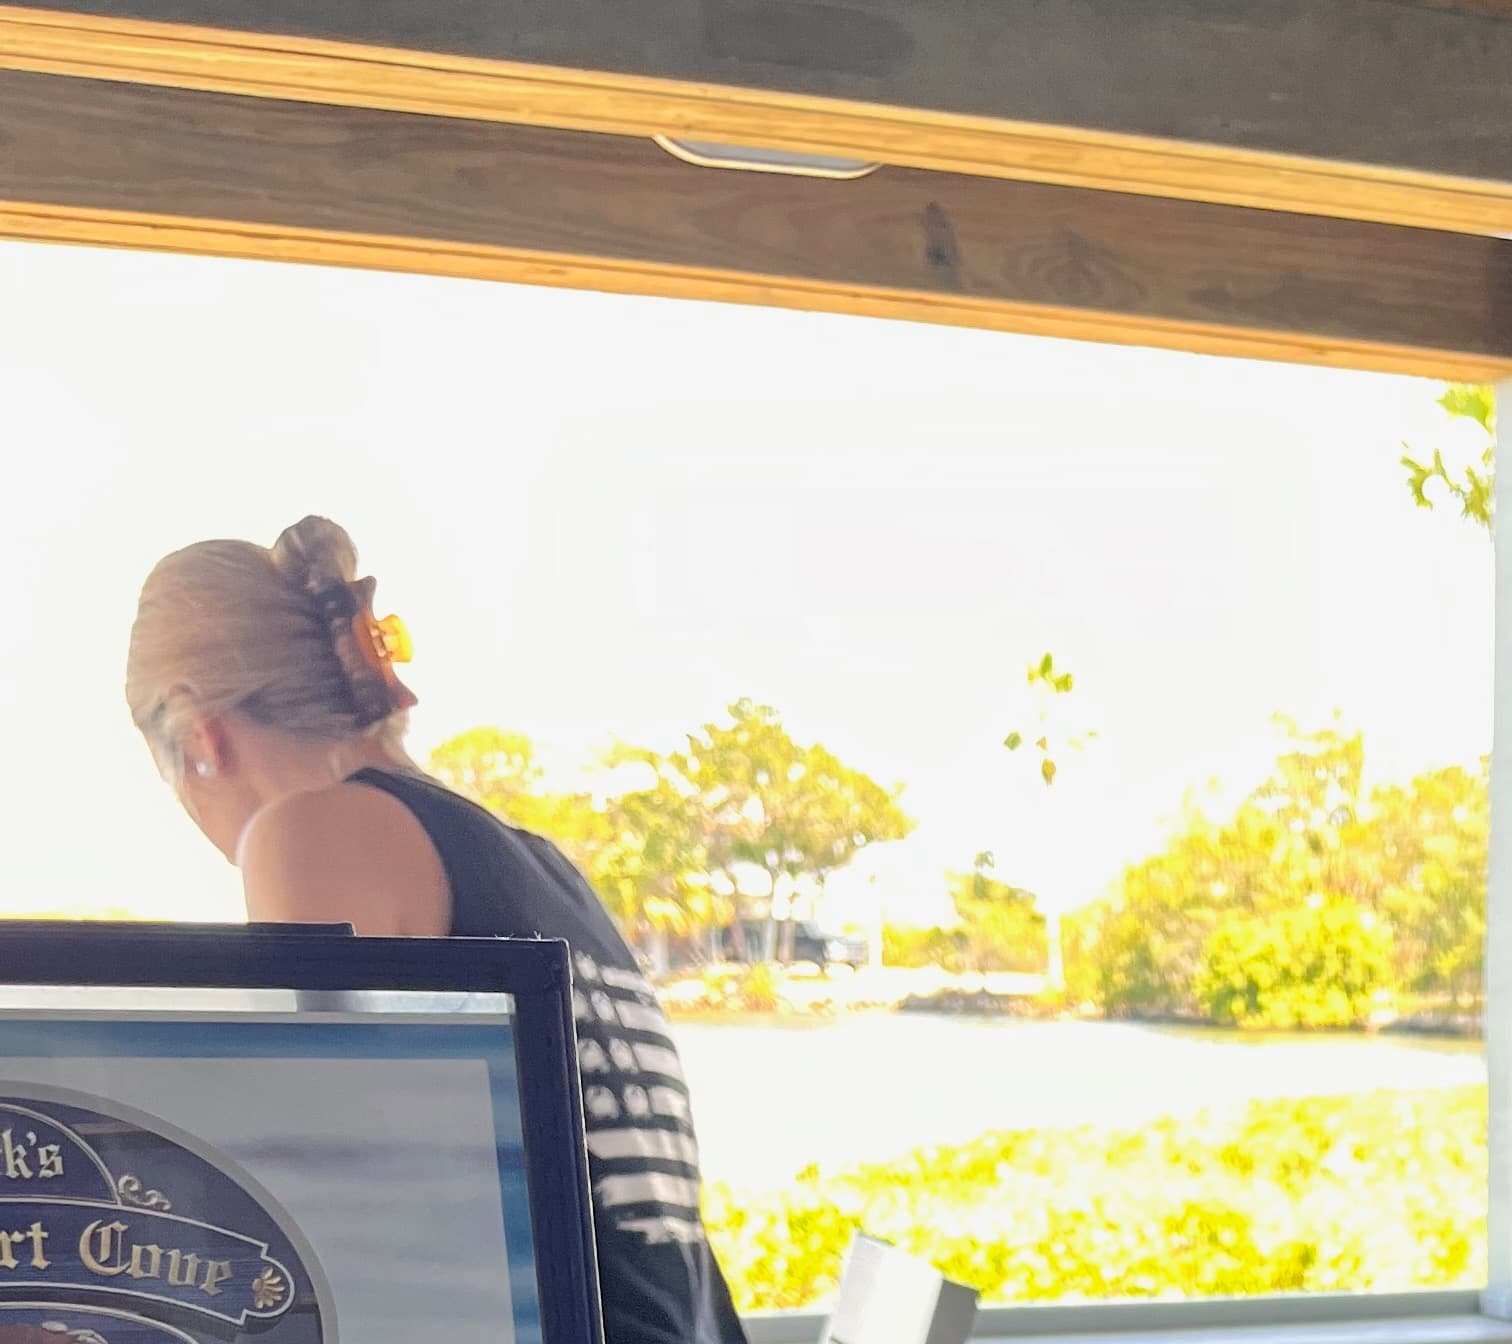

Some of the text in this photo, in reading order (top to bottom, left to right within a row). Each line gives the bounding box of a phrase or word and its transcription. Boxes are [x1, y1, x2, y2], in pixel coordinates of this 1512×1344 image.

[2, 1127, 64, 1178] k's
[0, 1220, 233, 1295] rt Cove
